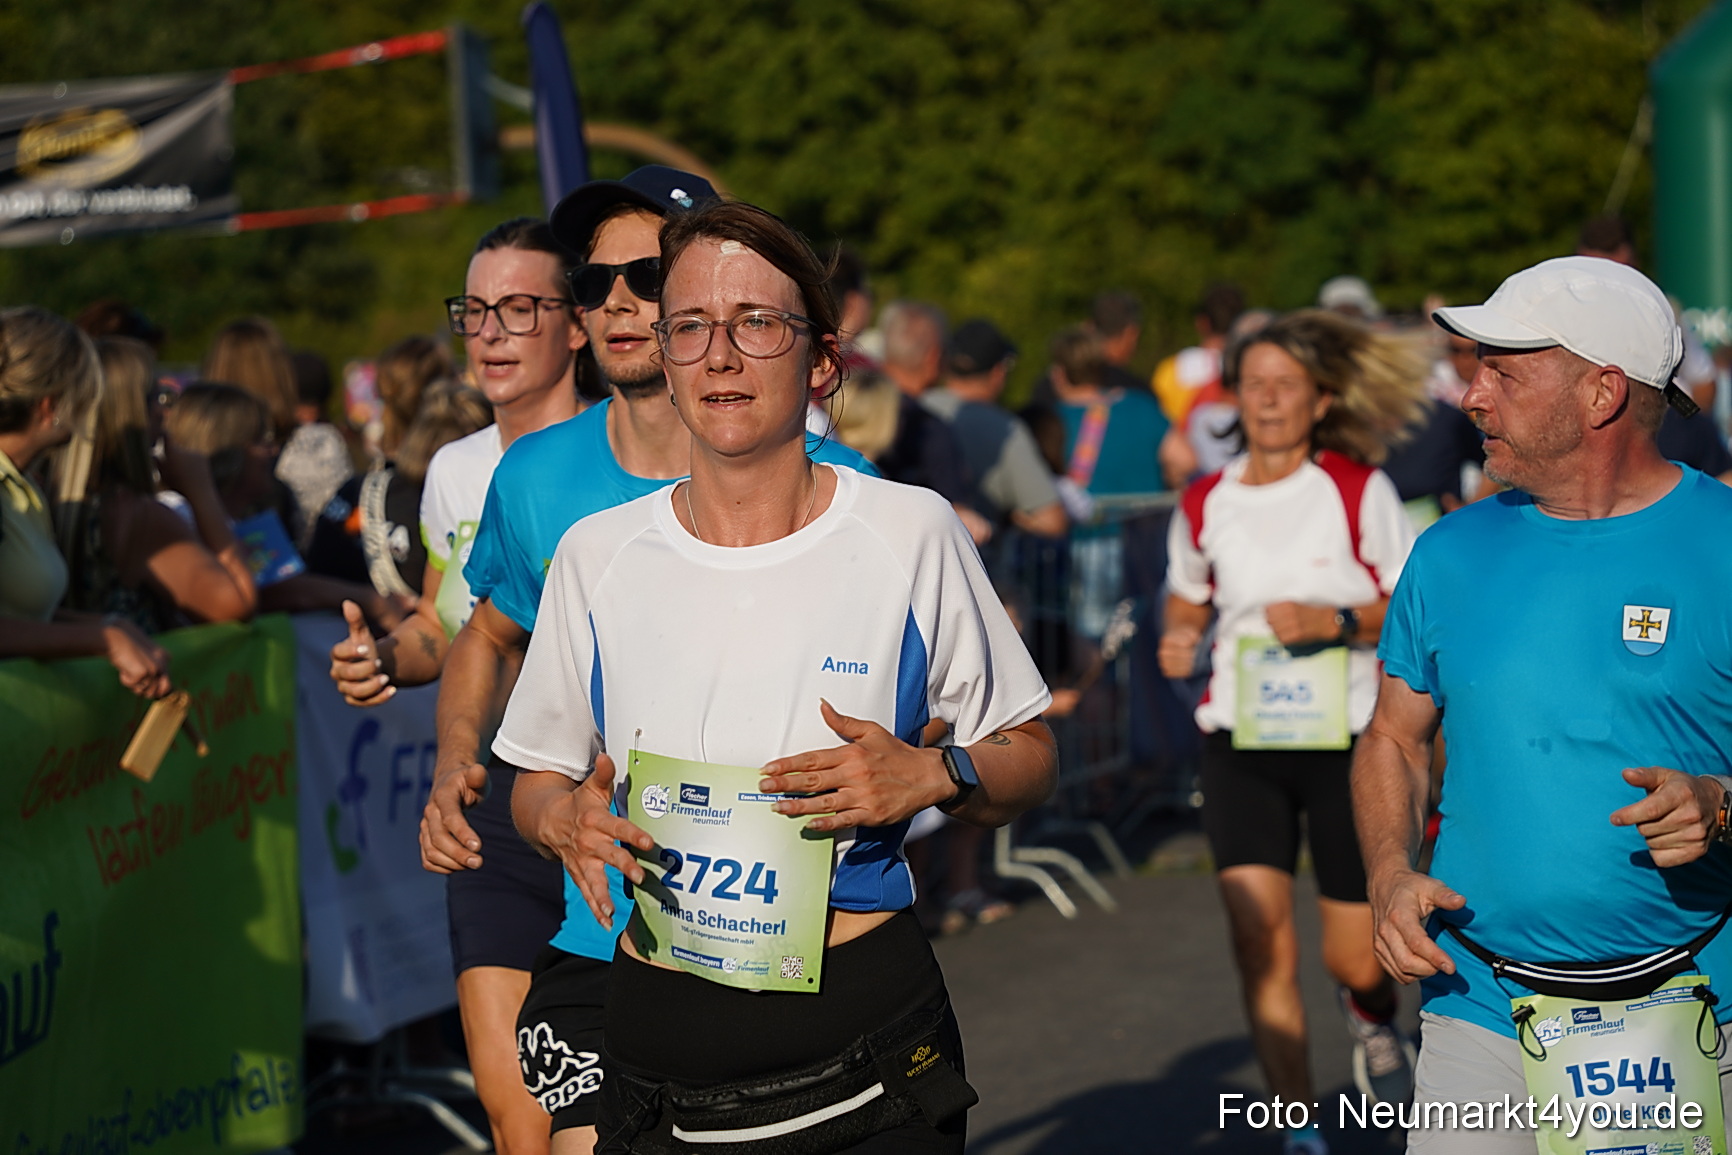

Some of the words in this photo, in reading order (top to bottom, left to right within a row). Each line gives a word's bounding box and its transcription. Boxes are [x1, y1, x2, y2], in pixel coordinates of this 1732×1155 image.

[821, 656, 868, 675] Anna
[671, 803, 733, 819] Firmenlauf
[692, 817, 730, 826] neumarkt
[659, 848, 779, 905] 2724
[660, 899, 694, 924] Anna
[697, 910, 787, 936] Schacherl
[740, 938, 755, 946] mbH
[1566, 1018, 1625, 1035] Firmenlauf
[1590, 1027, 1626, 1038] neumarkt
[1565, 1056, 1676, 1099] 1544
[538, 1068, 603, 1114] ppa
